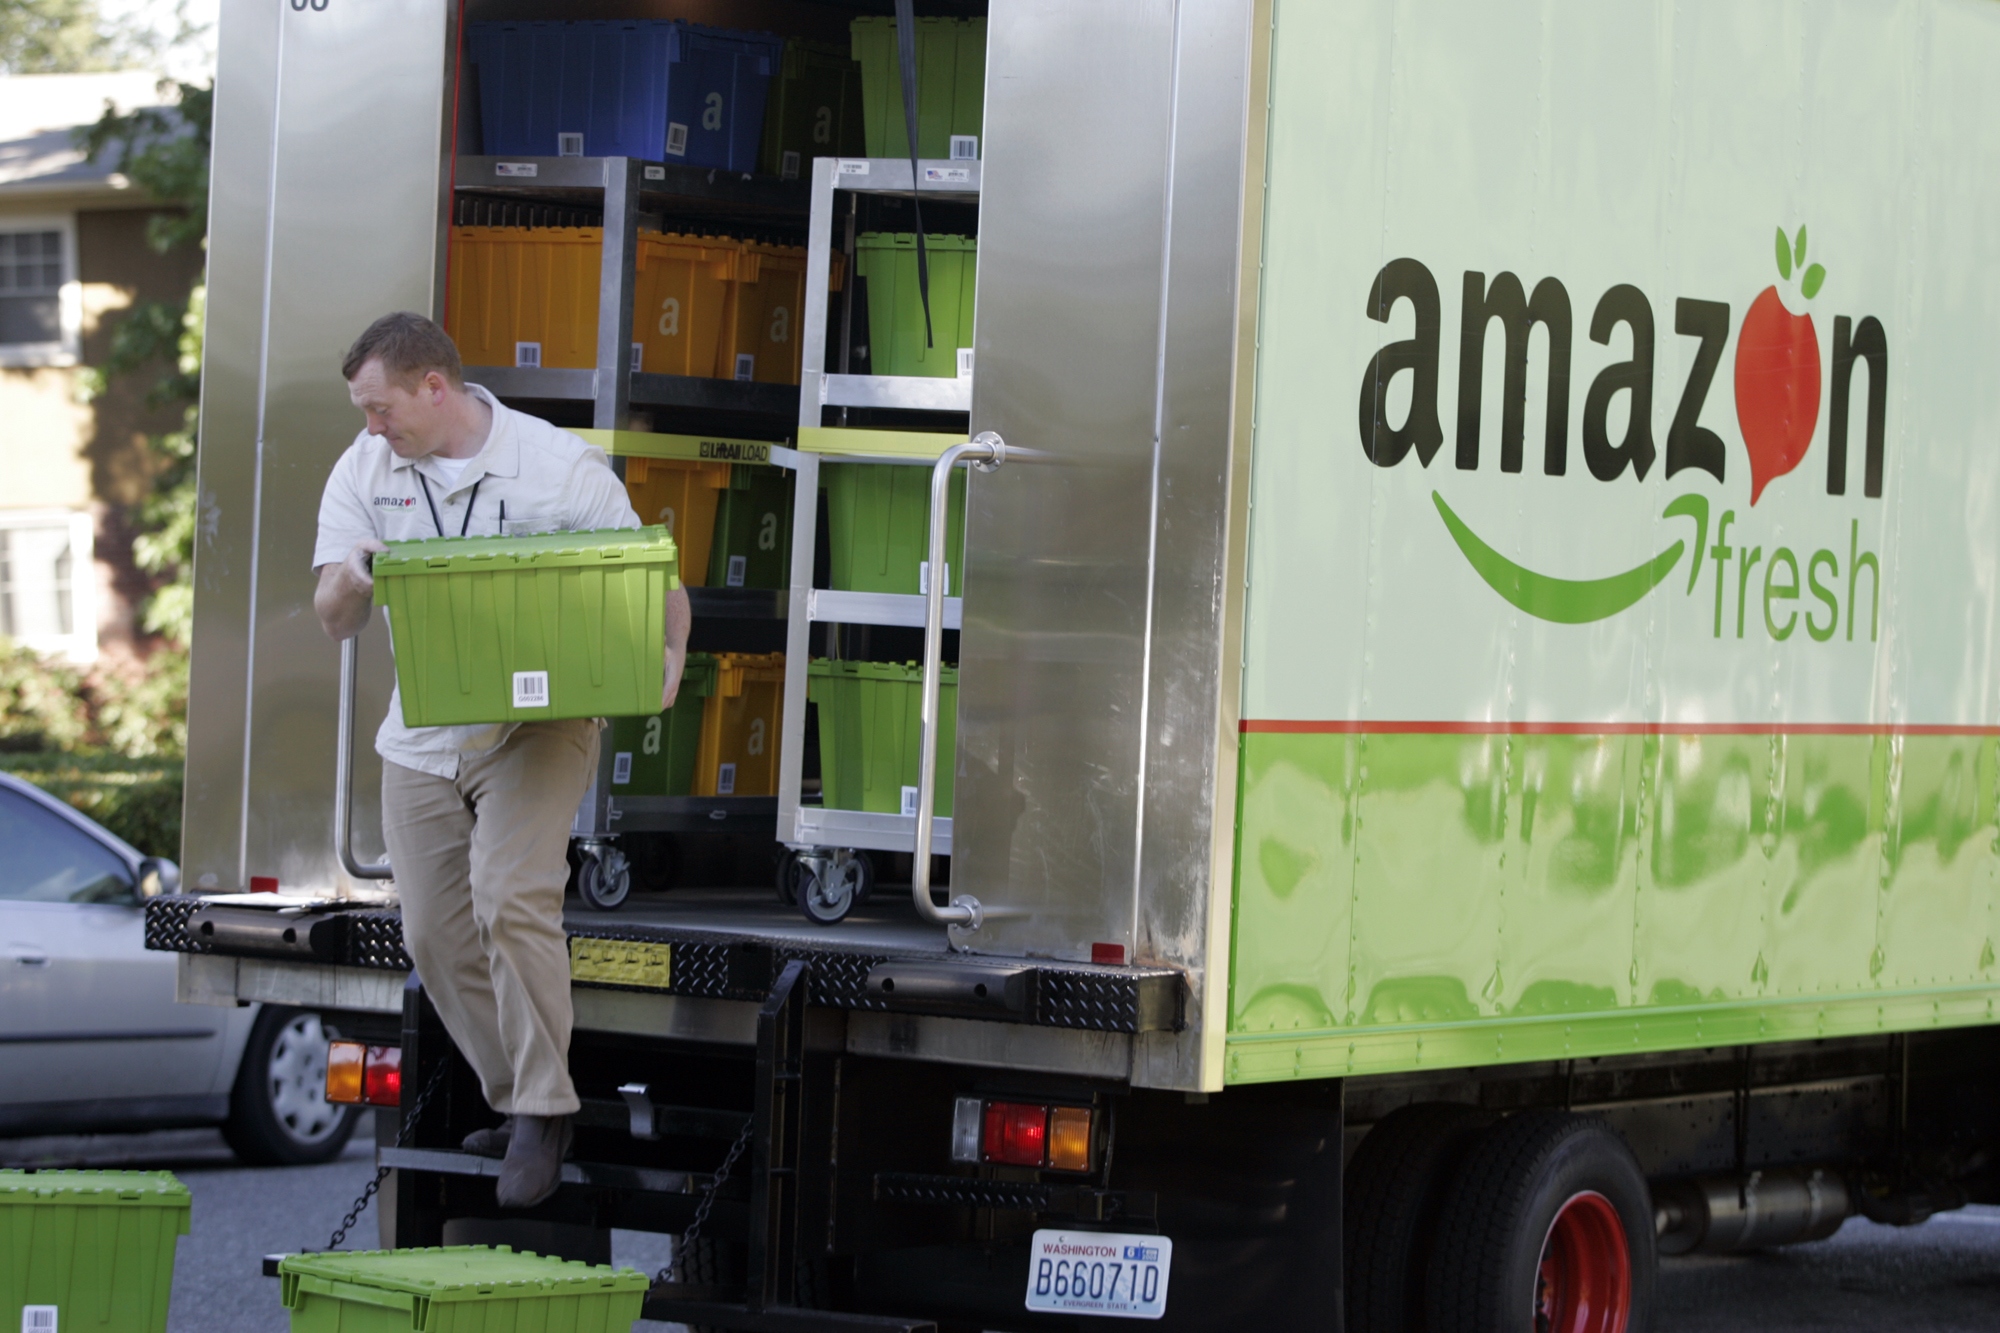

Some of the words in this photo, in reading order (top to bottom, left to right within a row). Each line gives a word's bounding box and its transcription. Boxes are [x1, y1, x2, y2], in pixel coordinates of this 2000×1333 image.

[702, 92, 722, 131] a
[813, 106, 831, 144] a
[659, 297, 679, 336] a
[770, 306, 788, 343] a
[1359, 257, 1888, 507] amazon
[742, 445, 768, 461] LOAD
[374, 496, 416, 507] amazon
[758, 512, 777, 550] a
[1710, 509, 1880, 642] fresh
[643, 716, 662, 755] a
[748, 718, 765, 755] a
[1043, 1243, 1117, 1257] WASHINGTON
[1036, 1258, 1159, 1303] B66071D
[1063, 1300, 1104, 1308] EVERGREEN
[1106, 1302, 1128, 1310] STATE
